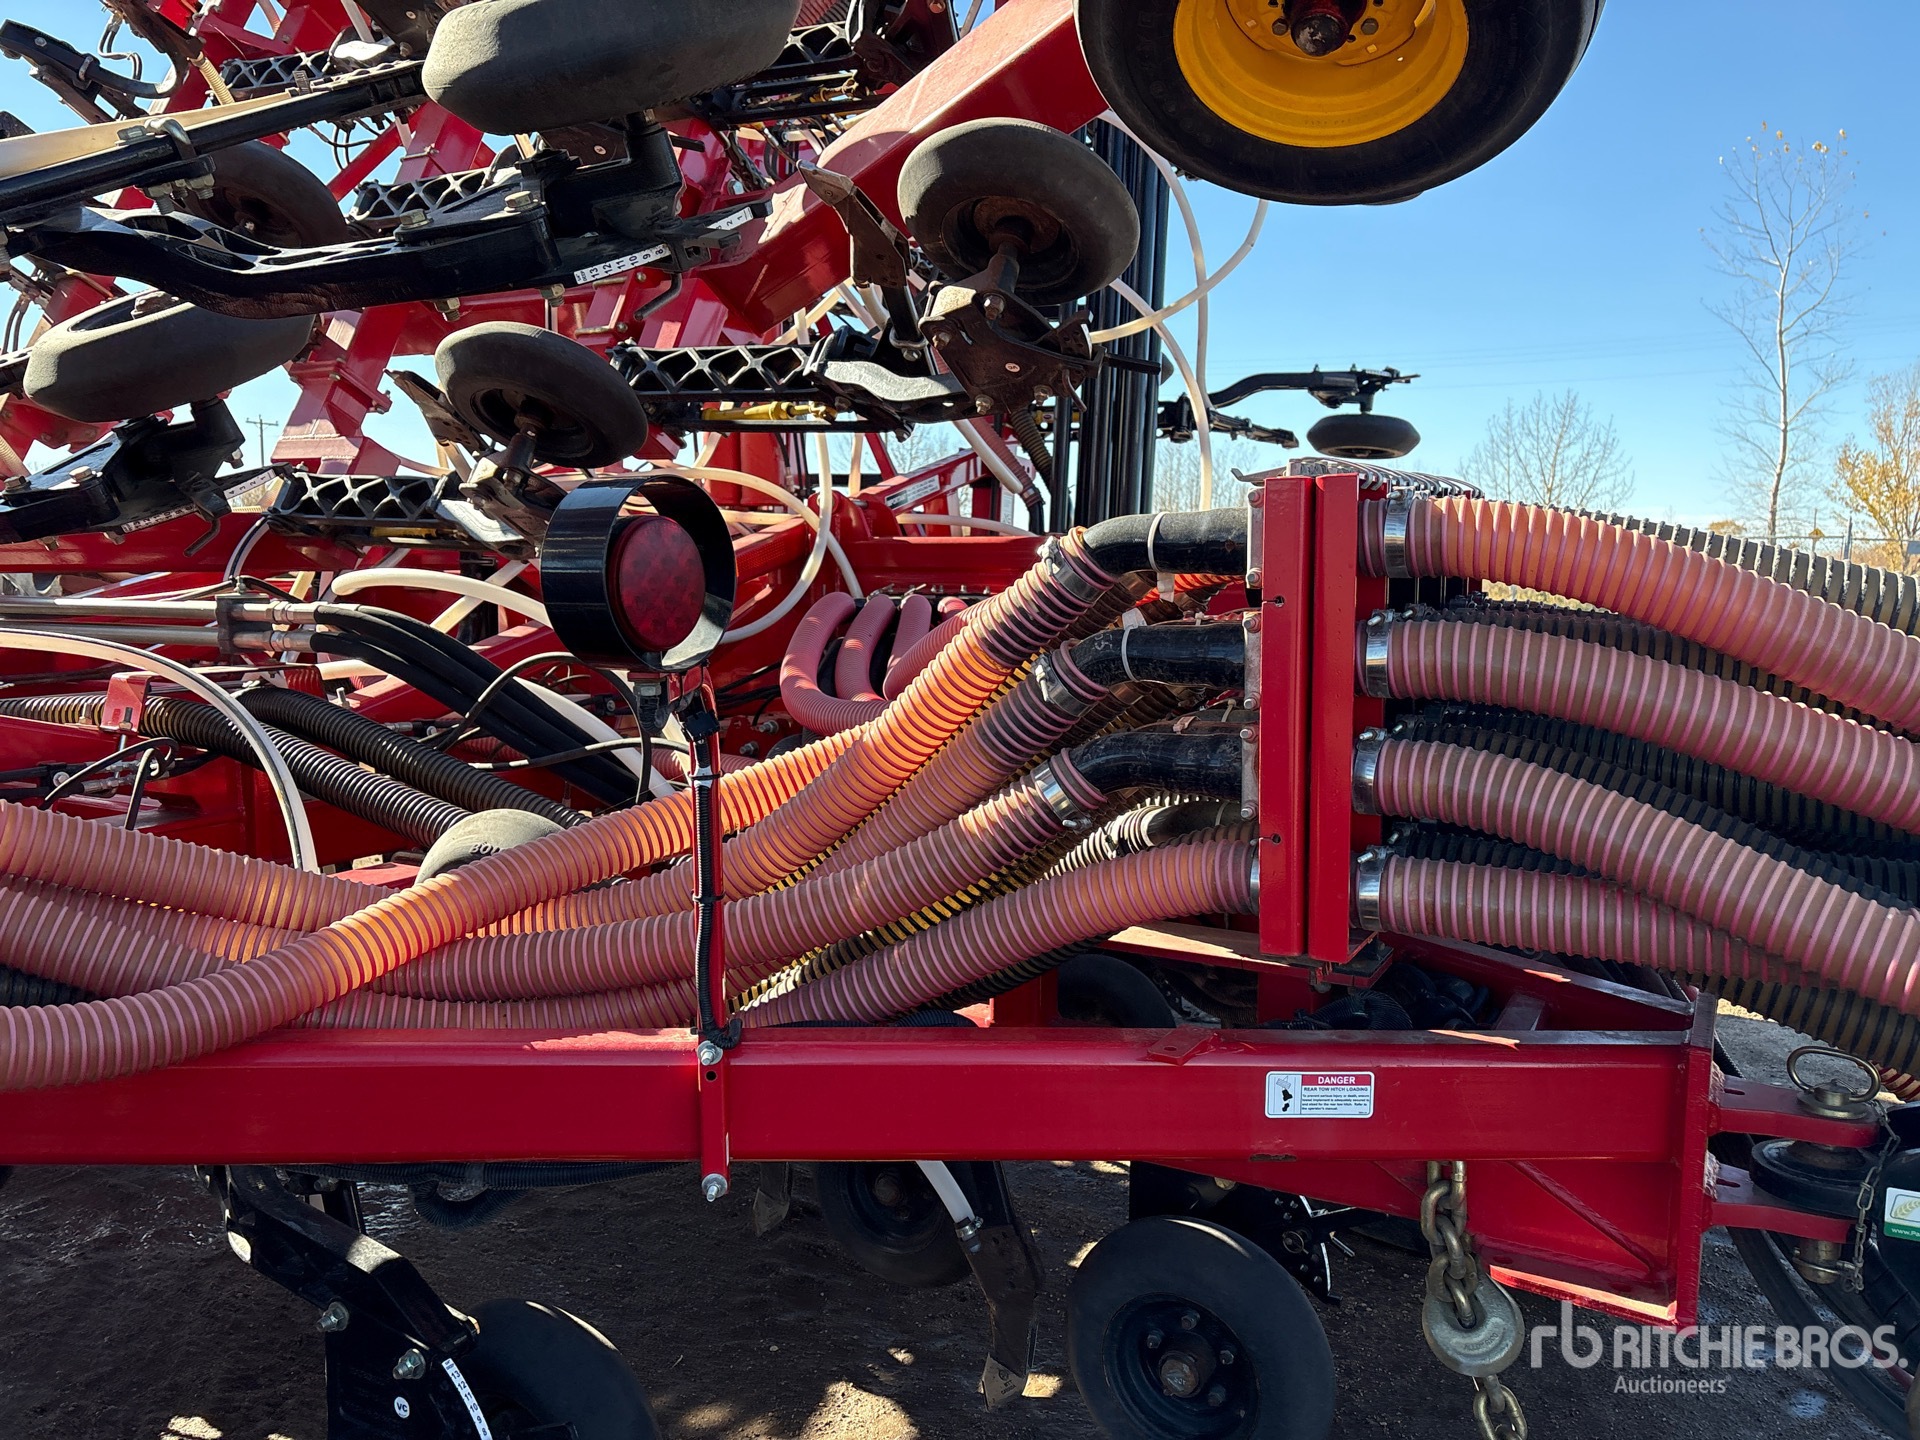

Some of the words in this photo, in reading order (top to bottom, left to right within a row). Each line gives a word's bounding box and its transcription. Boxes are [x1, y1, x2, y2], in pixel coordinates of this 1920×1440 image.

[617, 260, 626, 270] 11
[629, 256, 638, 266] 10
[590, 266, 600, 278] 13
[602, 262, 612, 274] 12
[451, 1370, 461, 1380] 13
[458, 1380, 467, 1390] 12
[464, 1392, 473, 1401] 11
[396, 1402, 408, 1412] VC
[470, 1403, 478, 1412] 10
